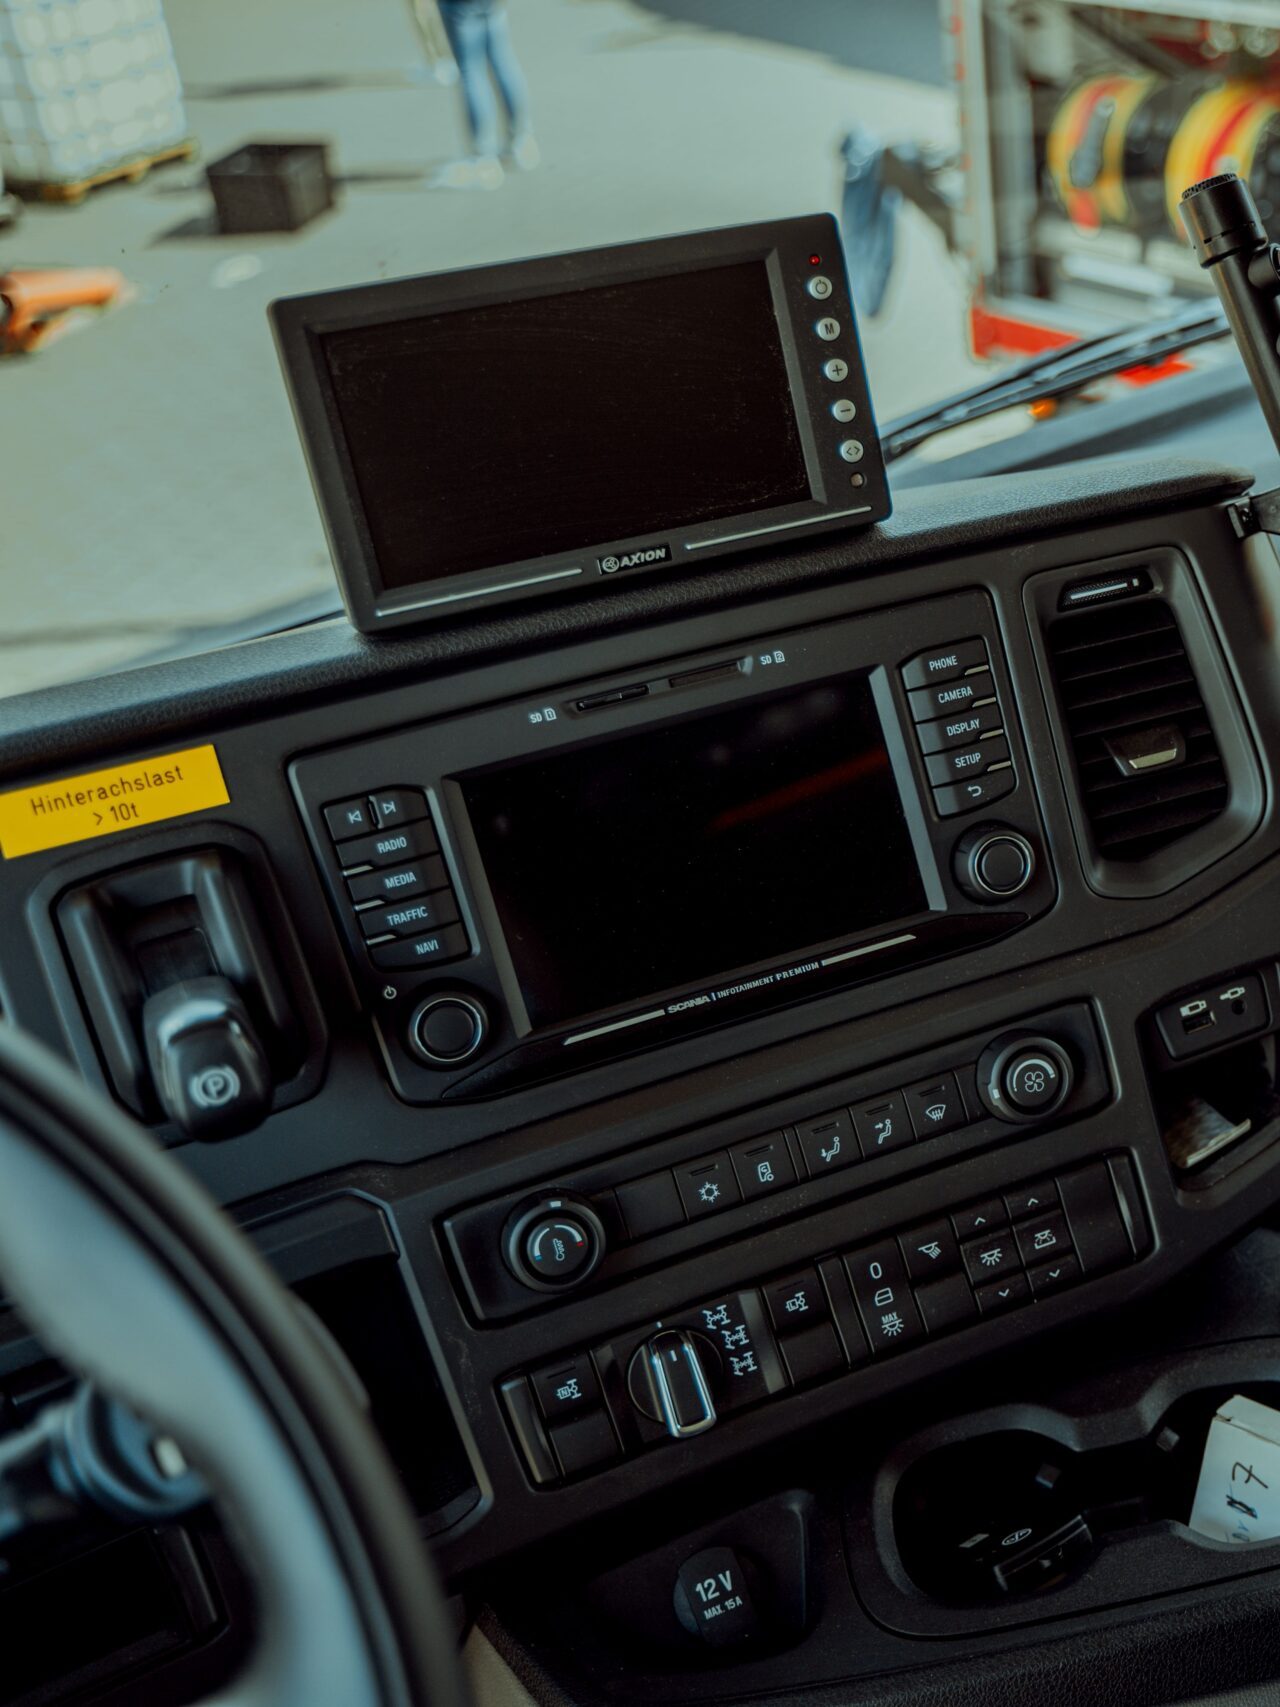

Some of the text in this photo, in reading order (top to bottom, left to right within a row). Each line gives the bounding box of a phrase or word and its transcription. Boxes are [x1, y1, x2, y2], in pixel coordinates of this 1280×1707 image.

[620, 548, 666, 567] AXION
[760, 654, 772, 665] SD
[928, 655, 958, 671] PHONE
[938, 686, 973, 704] CAMERA
[529, 713, 543, 724] SD
[946, 718, 980, 736] DISPLAY
[955, 752, 981, 768] SETUP
[30, 765, 184, 817] Hinterachslast
[109, 802, 140, 823] 10t
[376, 836, 408, 854] RADIO
[384, 871, 417, 889] MEDIA
[386, 906, 429, 927] TRAFFIC
[415, 939, 440, 955] NAVI
[667, 962, 820, 1014] SCANIA INFOTAINMENT PREMIUM
[881, 1311, 899, 1325] MAX
[1231, 1461, 1269, 1489] 7
[695, 1570, 732, 1602] 12 V
[703, 1604, 726, 1620] MAX.
